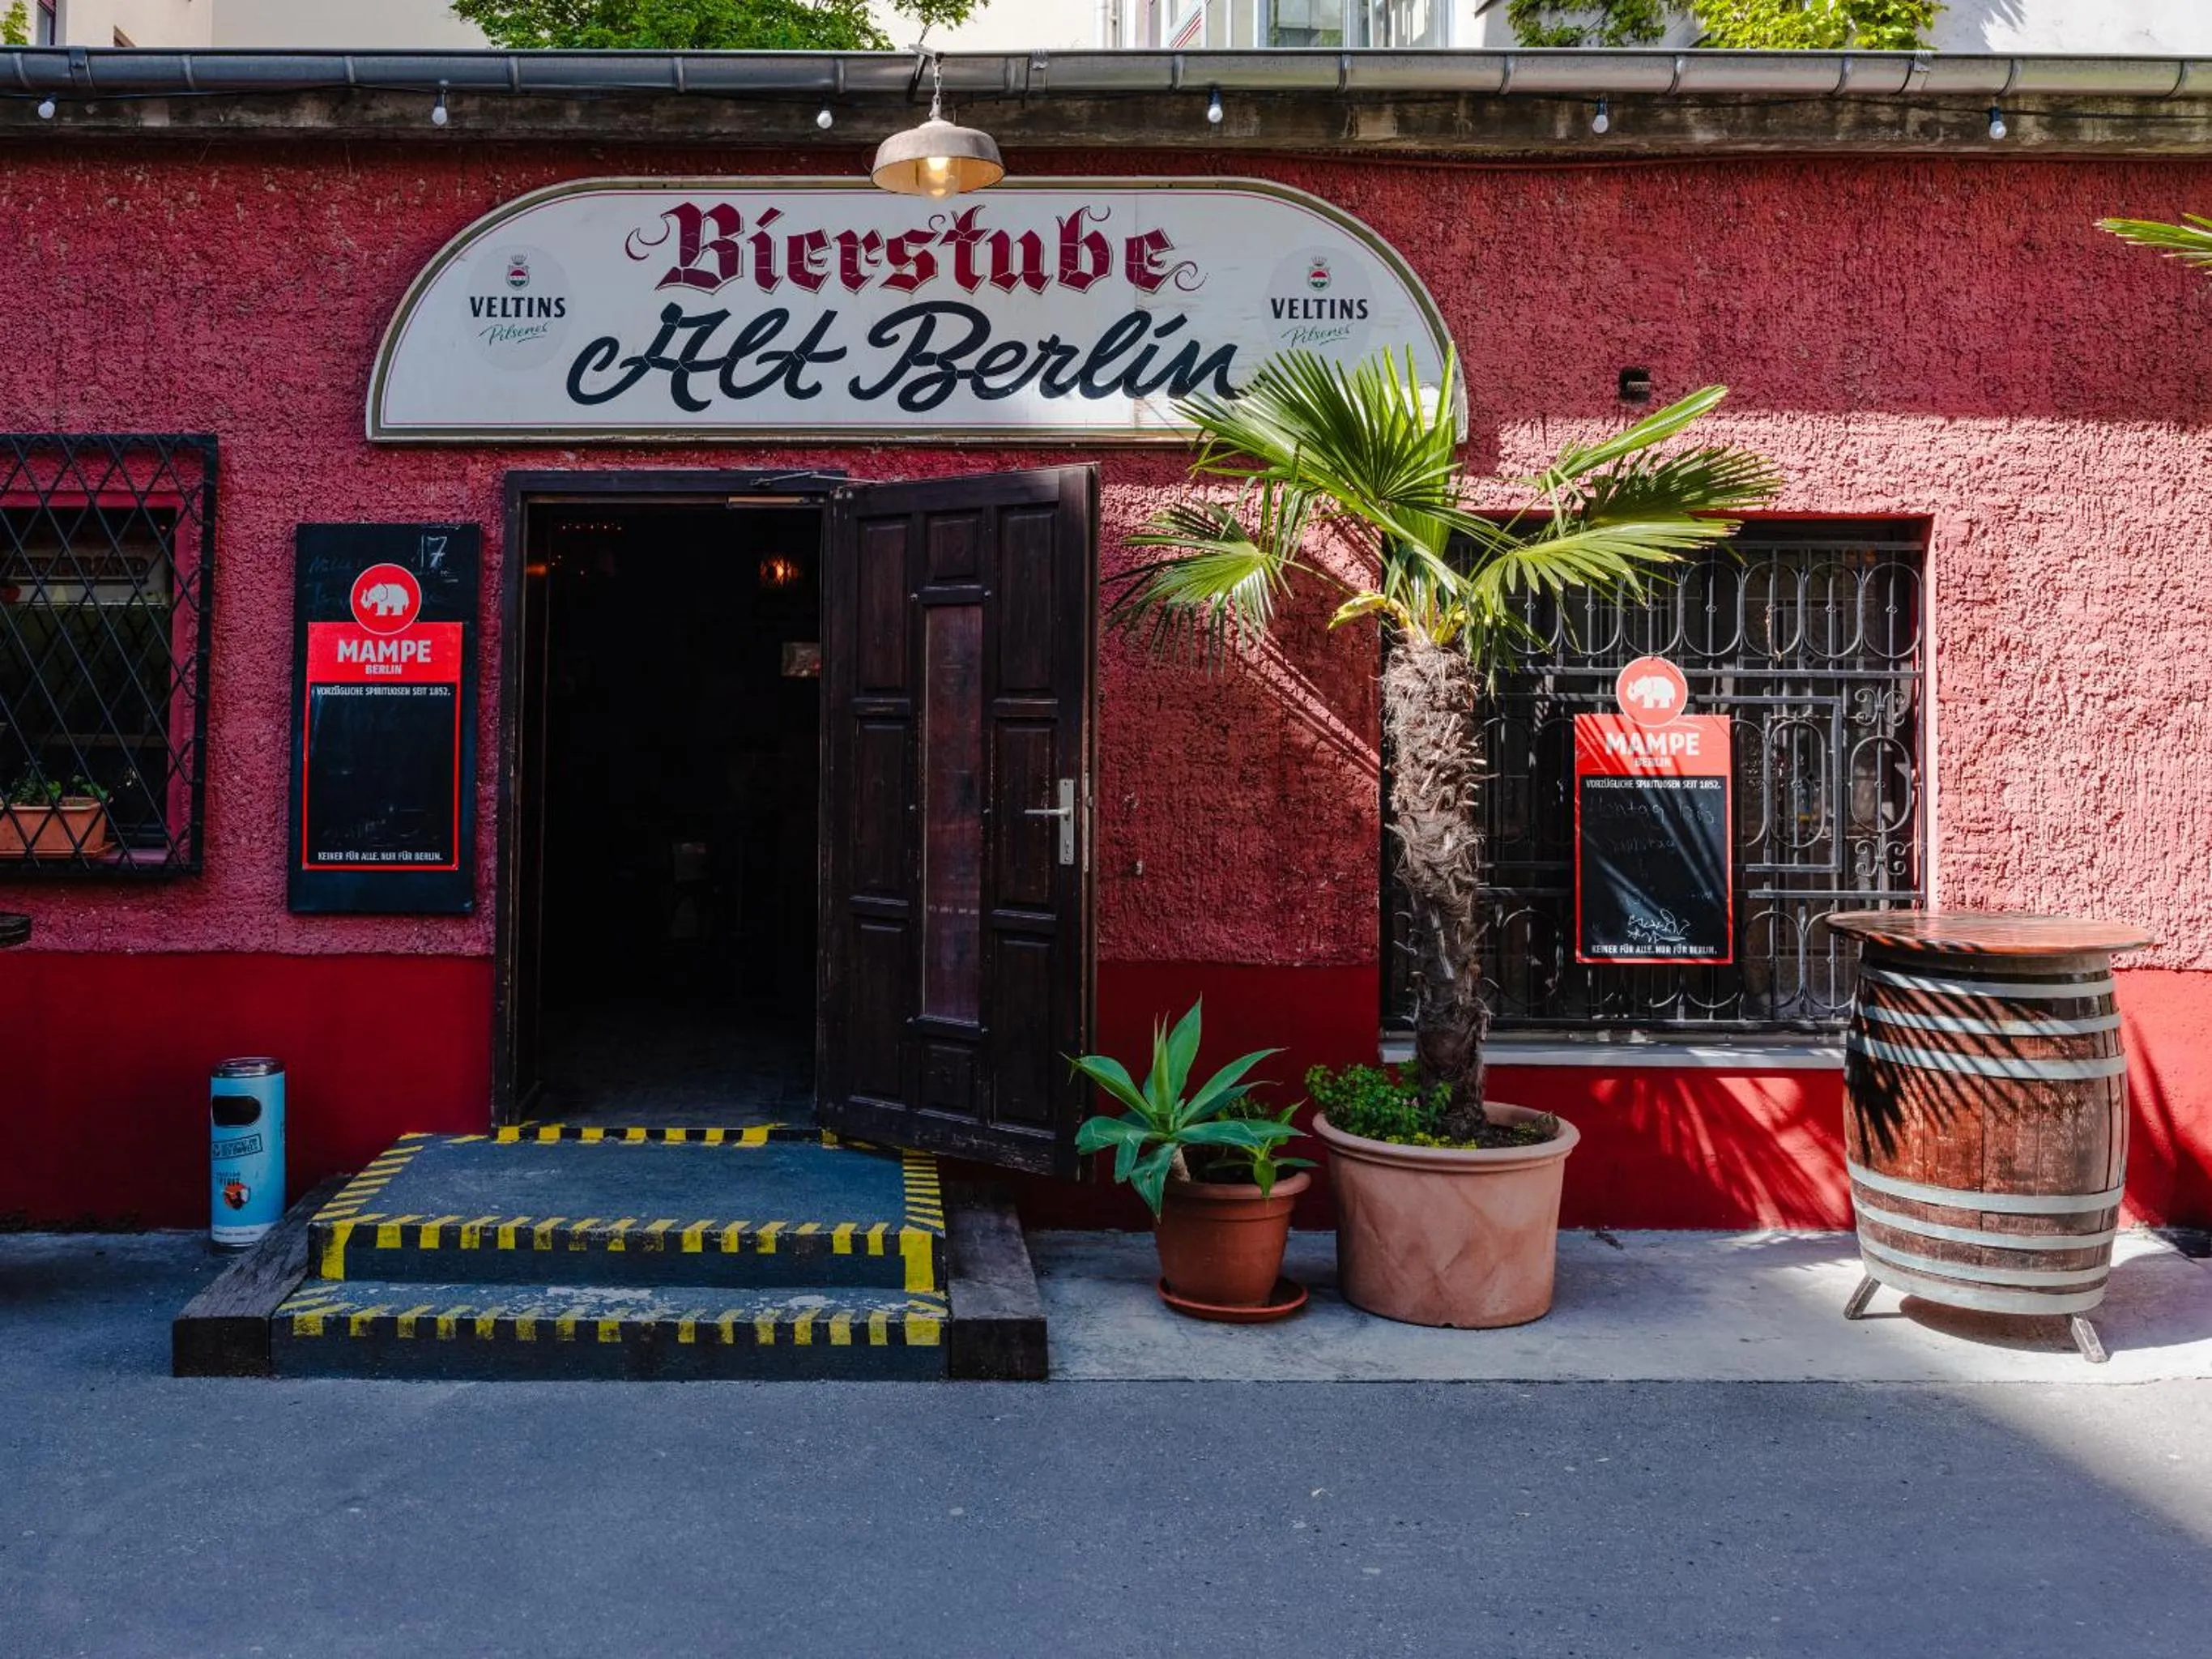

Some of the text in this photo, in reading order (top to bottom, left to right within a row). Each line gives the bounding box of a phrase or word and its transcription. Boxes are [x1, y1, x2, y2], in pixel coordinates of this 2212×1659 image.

[625, 202, 1209, 295] Bierstube
[469, 296, 566, 318] VELTINS
[1270, 297, 1369, 320] VELTINS
[478, 322, 552, 346] Pilsener
[1280, 323, 1354, 348] Pilsener
[566, 300, 1267, 413] Alt Berlin
[337, 639, 432, 663] MAMPE
[364, 664, 403, 675] BERLIN
[412, 687, 428, 696] SEIT
[1605, 732, 1700, 756] MAMPE
[1633, 757, 1672, 768] BERLIN
[1682, 779, 1697, 789] SEIT
[318, 851, 343, 860] KEINER
[345, 851, 360, 860] FÜR
[398, 851, 412, 860] FÜR
[1592, 945, 1618, 954] KEINER
[1620, 943, 1634, 954] FÜR
[1673, 943, 1687, 954] FÜR
